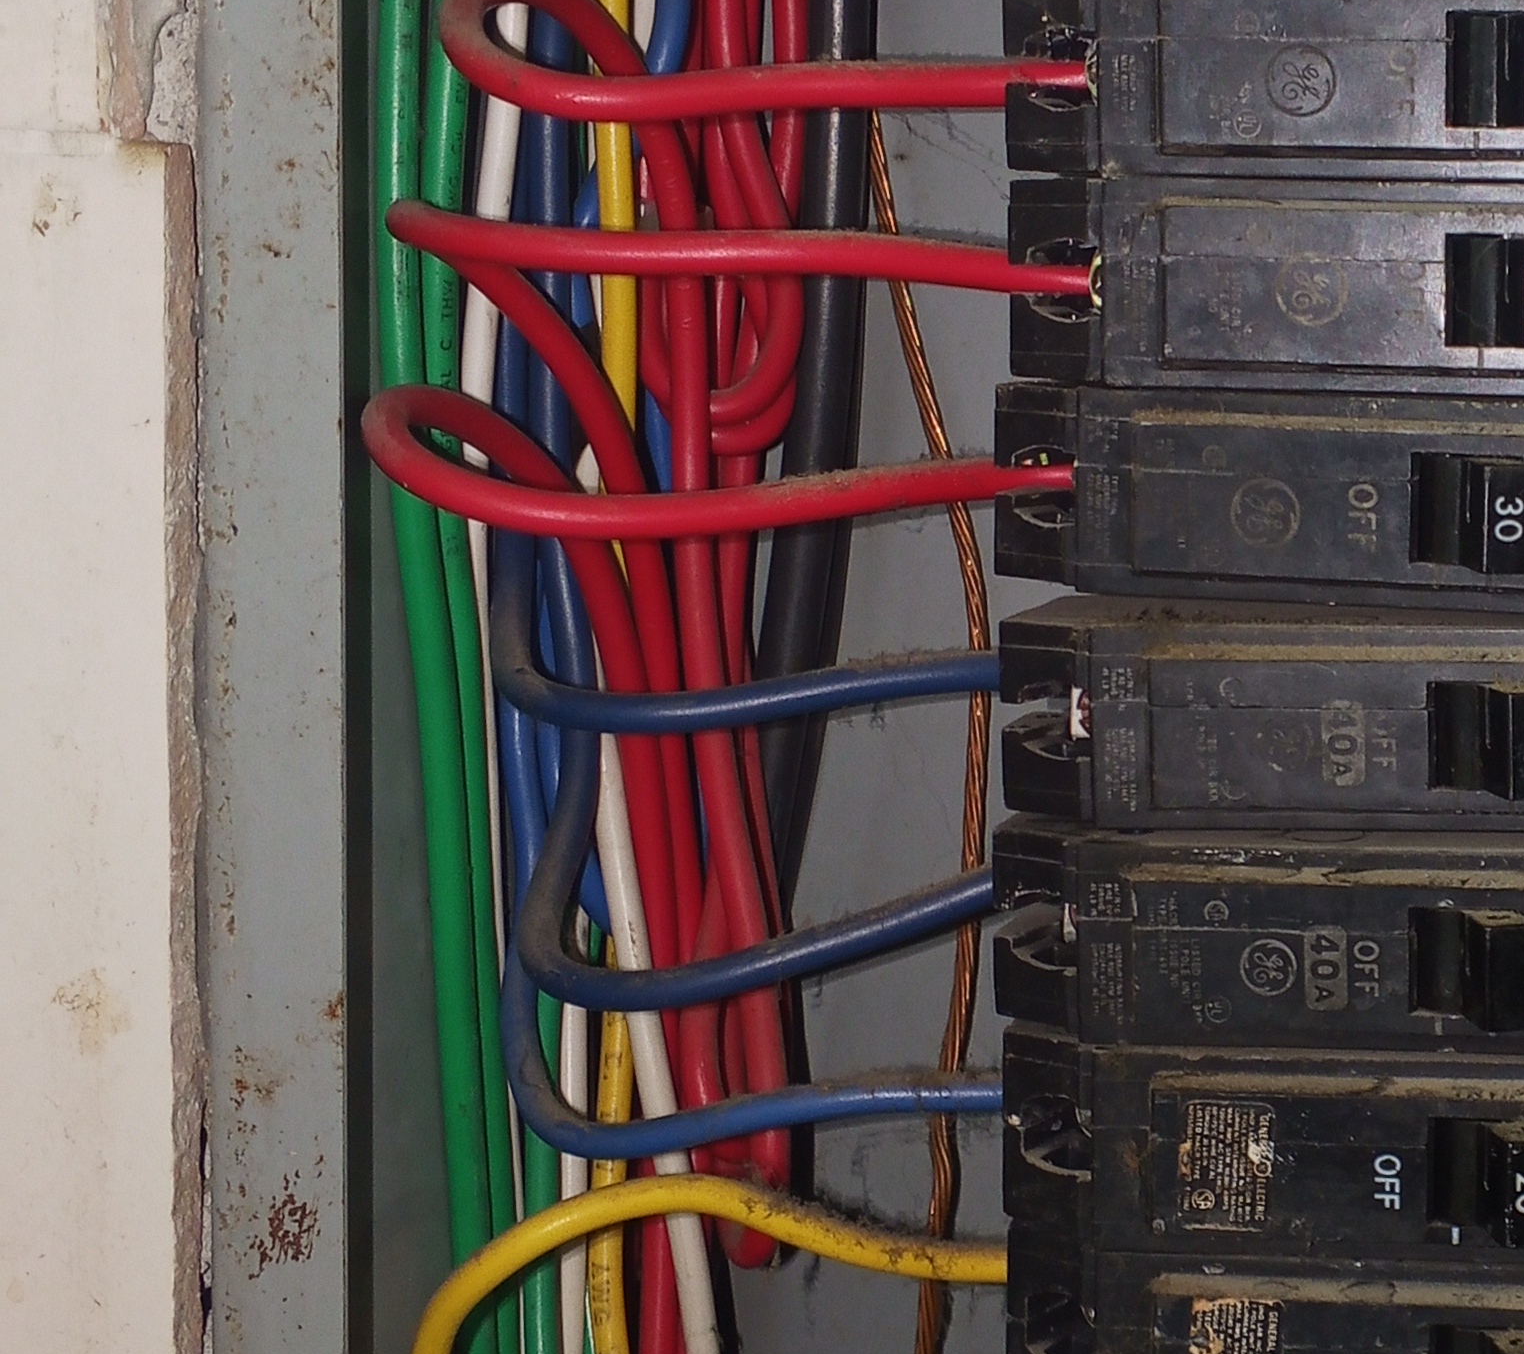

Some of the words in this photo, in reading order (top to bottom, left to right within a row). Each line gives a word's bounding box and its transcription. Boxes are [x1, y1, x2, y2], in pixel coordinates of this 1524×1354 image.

[1348, 483, 1379, 553] OFF
[1494, 494, 1524, 544] 30
[1309, 933, 1341, 1004] 40A
[1352, 939, 1381, 998] OFF
[1373, 1154, 1401, 1210] OFF
